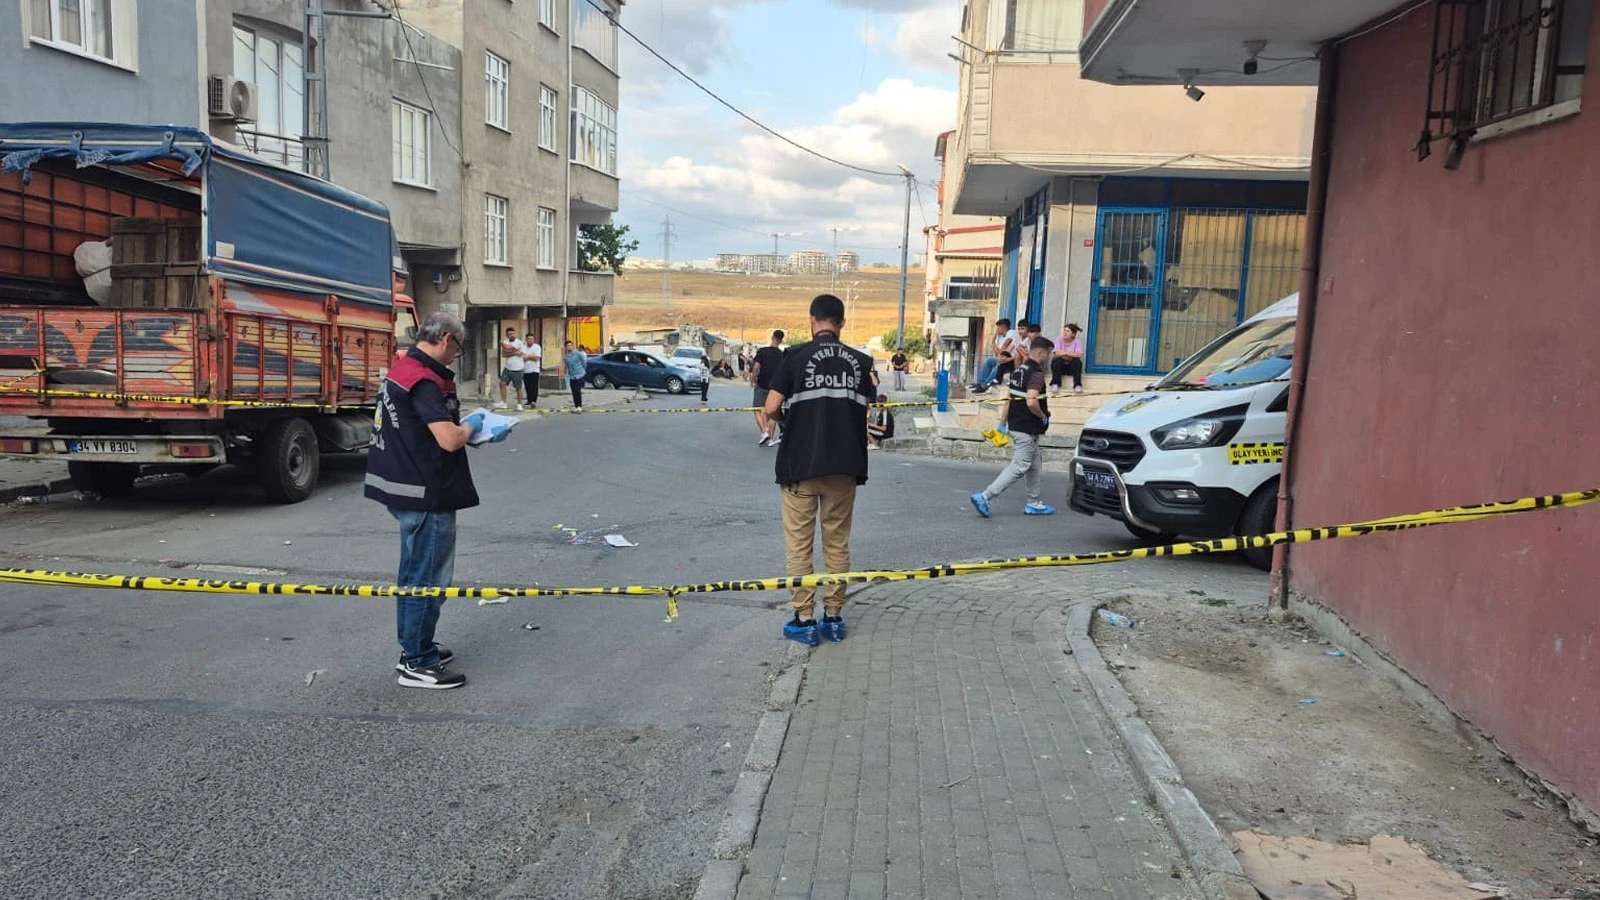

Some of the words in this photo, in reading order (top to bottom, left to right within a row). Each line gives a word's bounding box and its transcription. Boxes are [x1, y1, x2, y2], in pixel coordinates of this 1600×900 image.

[805, 361, 816, 388] OLAY
[815, 371, 854, 388] POLİS
[78, 441, 89, 452] 34
[110, 441, 134, 452] 8304
[1233, 449, 1250, 458] OLAY
